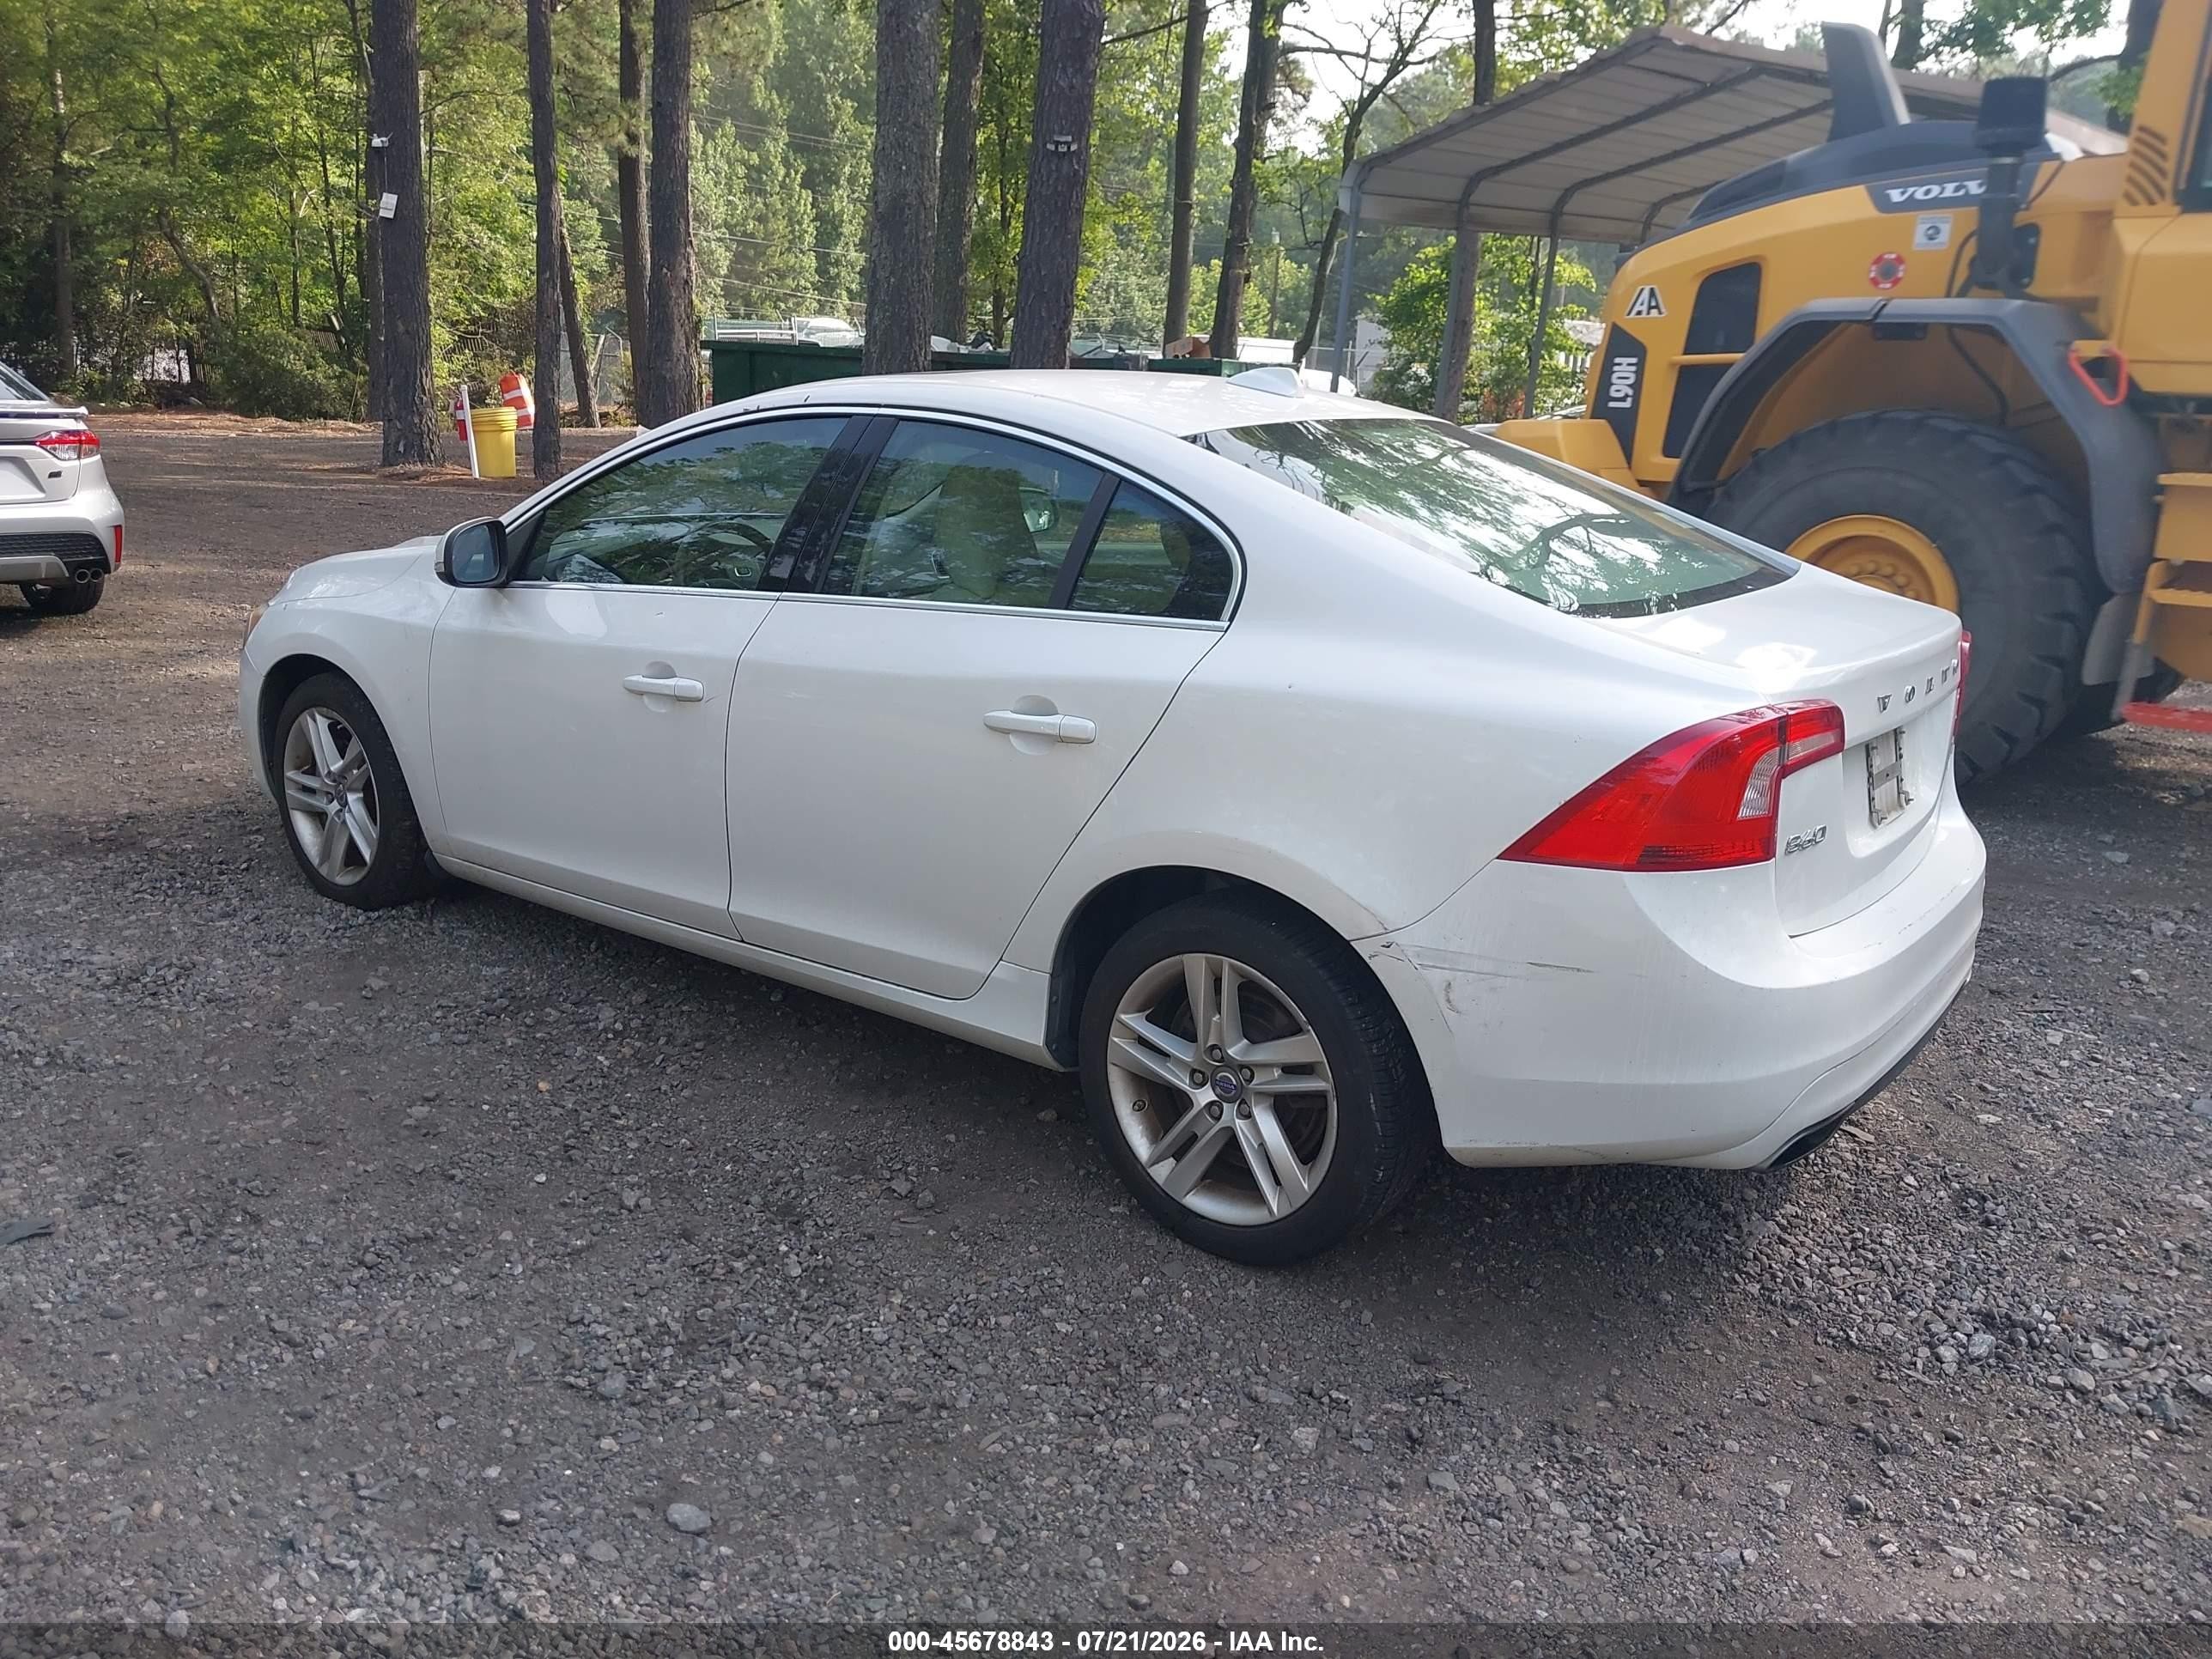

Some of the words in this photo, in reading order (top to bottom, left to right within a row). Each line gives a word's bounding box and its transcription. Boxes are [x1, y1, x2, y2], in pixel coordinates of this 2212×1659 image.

[1884, 179, 1988, 203] VOLV
[1607, 356, 1639, 408] L90H
[1784, 824, 1827, 856] S60
